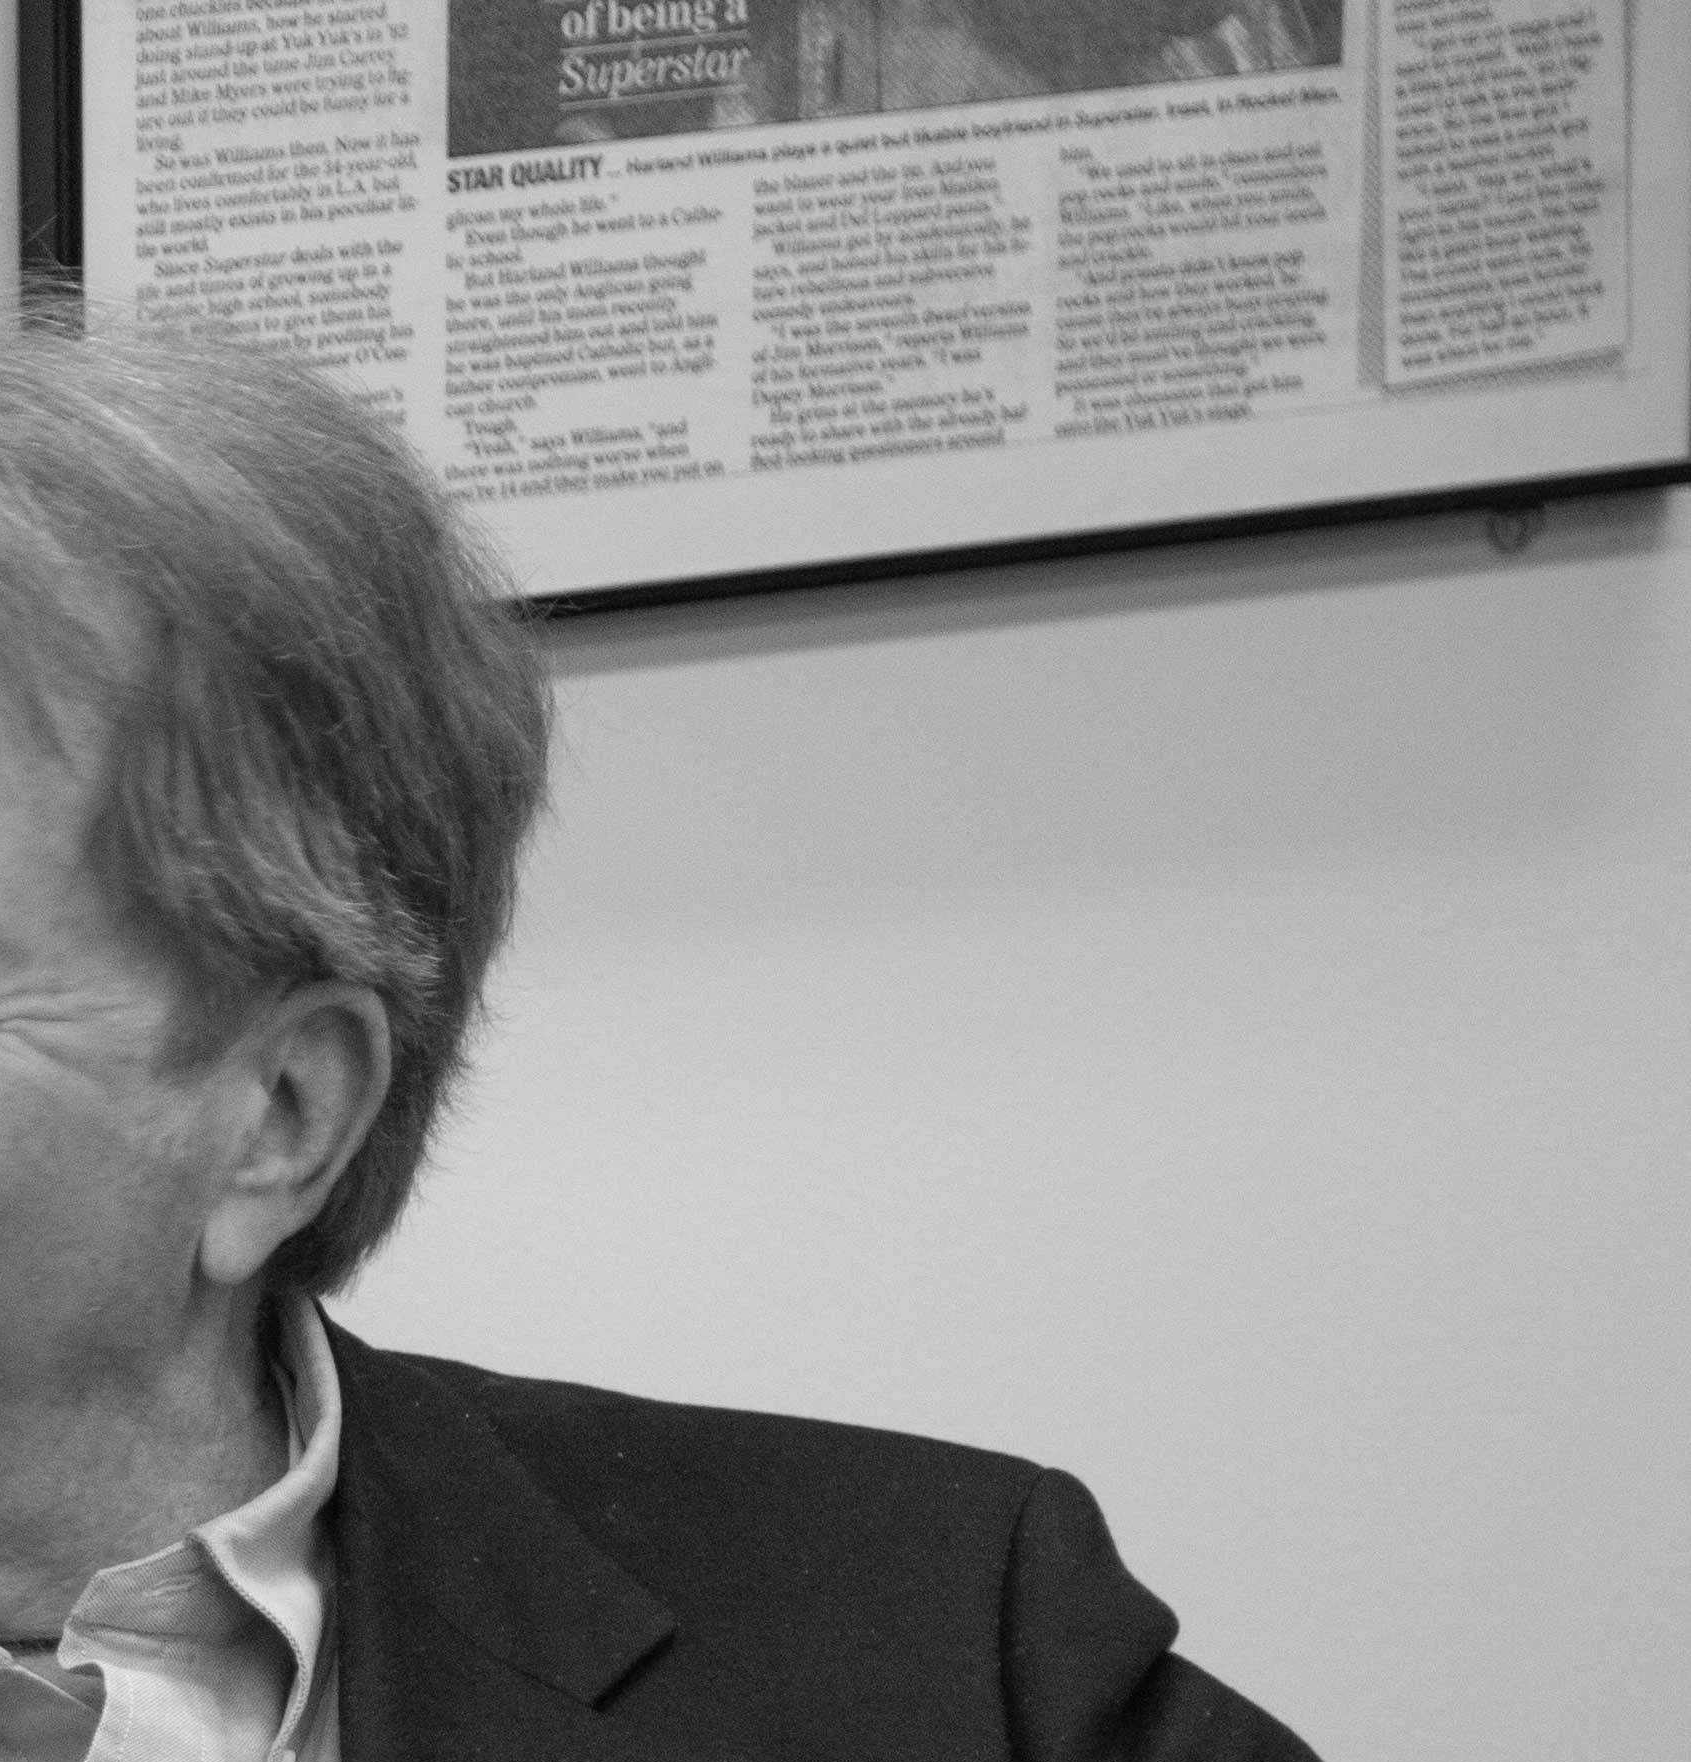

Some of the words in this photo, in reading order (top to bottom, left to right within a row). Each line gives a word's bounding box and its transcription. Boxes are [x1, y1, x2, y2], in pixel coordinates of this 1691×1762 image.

[559, 0, 606, 40] of
[610, 0, 717, 34] being
[723, 0, 750, 23] a
[558, 44, 751, 100] Superstar
[446, 164, 504, 193] STAR
[510, 154, 602, 186] QUALITY
